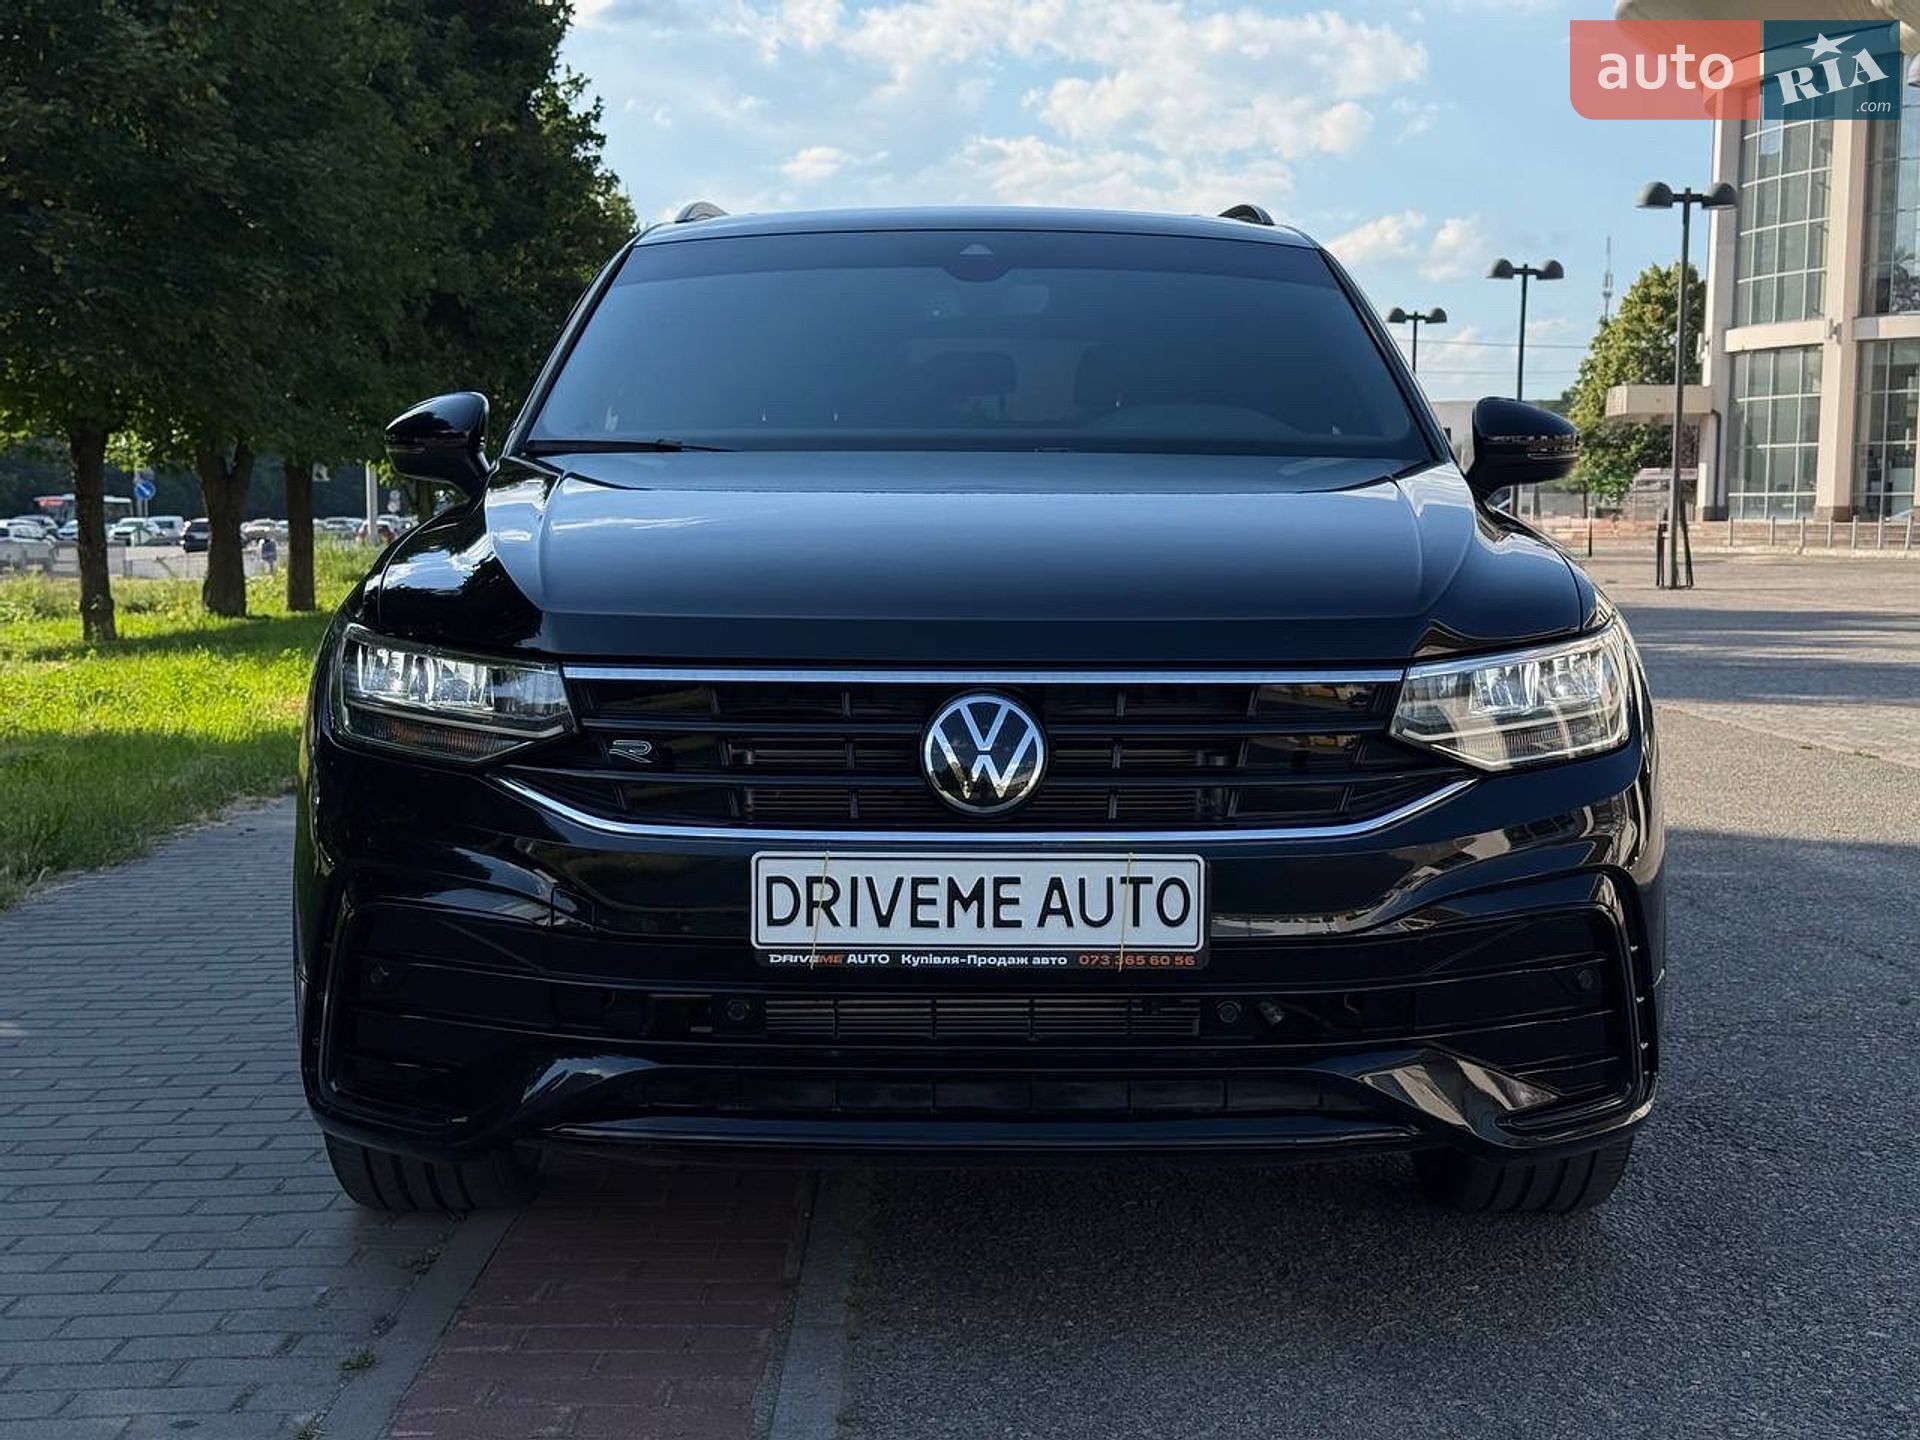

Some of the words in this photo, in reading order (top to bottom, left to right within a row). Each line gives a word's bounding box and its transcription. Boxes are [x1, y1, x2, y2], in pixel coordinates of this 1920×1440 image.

[766, 876, 1022, 928] DRIVEME
[1037, 876, 1191, 928] AUTO
[846, 953, 891, 965] AUTO
[901, 953, 1029, 967] Купівля-Продаж
[1032, 955, 1068, 965] авто
[1079, 954, 1111, 966] 073
